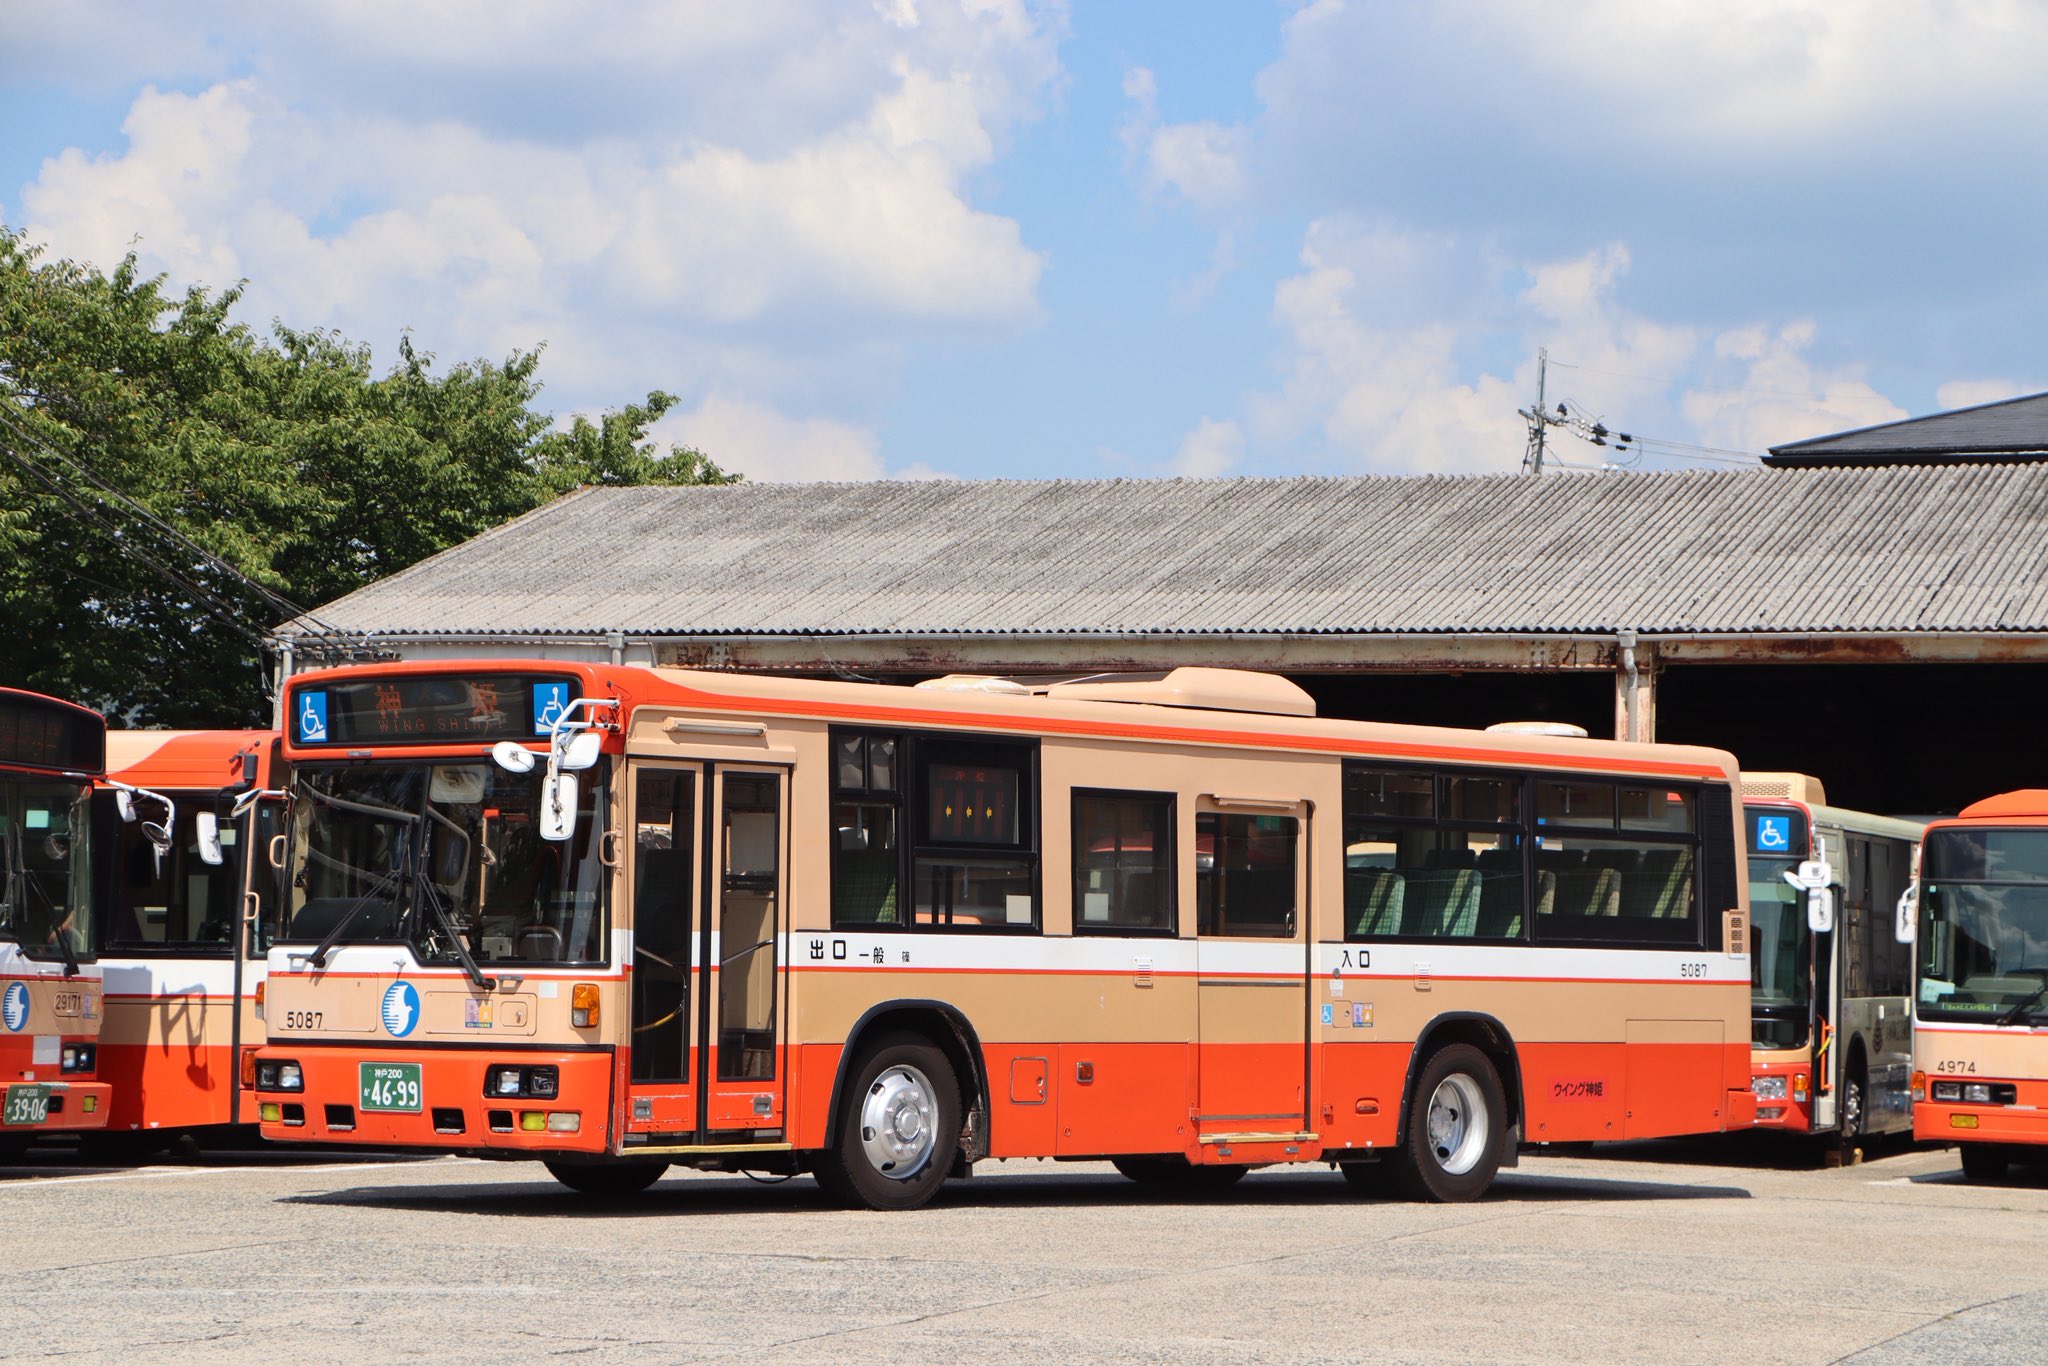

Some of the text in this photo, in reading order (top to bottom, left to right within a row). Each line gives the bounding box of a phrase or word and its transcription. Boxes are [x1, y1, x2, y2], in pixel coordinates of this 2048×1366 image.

[377, 718, 425, 733] WING
[810, 939, 847, 960] 出口
[859, 946, 884, 964] 一般
[1342, 950, 1370, 968] 入口
[1681, 963, 1707, 978] 5087
[55, 994, 81, 1010] 29171
[287, 1011, 323, 1029] 5087
[1937, 1060, 1976, 1074] 4974
[371, 1079, 418, 1107] 46-99
[11, 1098, 48, 1121] 39-06
